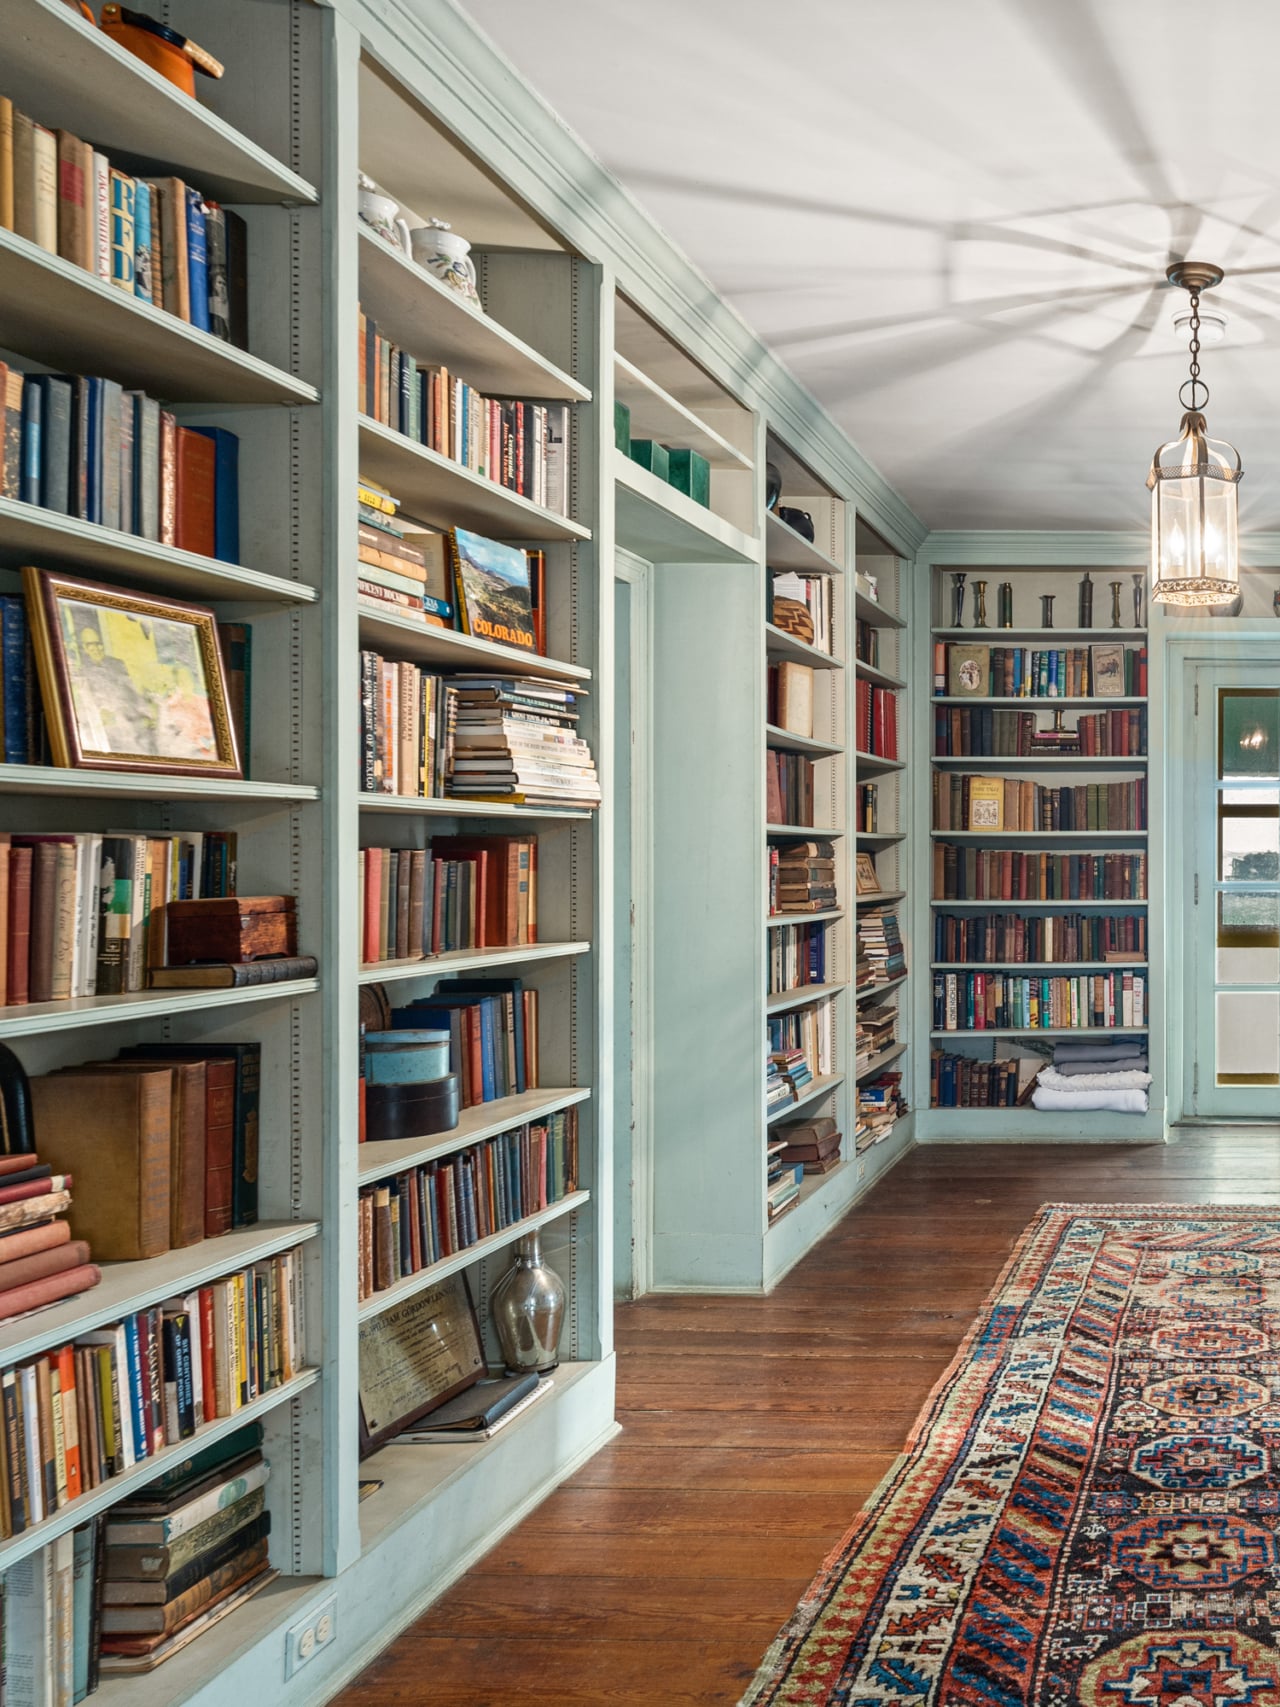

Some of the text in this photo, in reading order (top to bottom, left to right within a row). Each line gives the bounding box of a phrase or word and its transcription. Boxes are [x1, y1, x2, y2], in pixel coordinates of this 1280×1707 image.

[97, 171, 107, 202] JACK
[110, 177, 135, 283] RFD
[449, 531, 460, 578] COLORADO
[472, 617, 533, 647] COLORADO
[365, 679, 373, 731] CONQUEST
[366, 734, 373, 746] OF
[371, 1313, 400, 1333] WILLIAM
[175, 1334, 185, 1414] OF GREAT POETRY
[183, 1355, 192, 1405] CENTURIES
